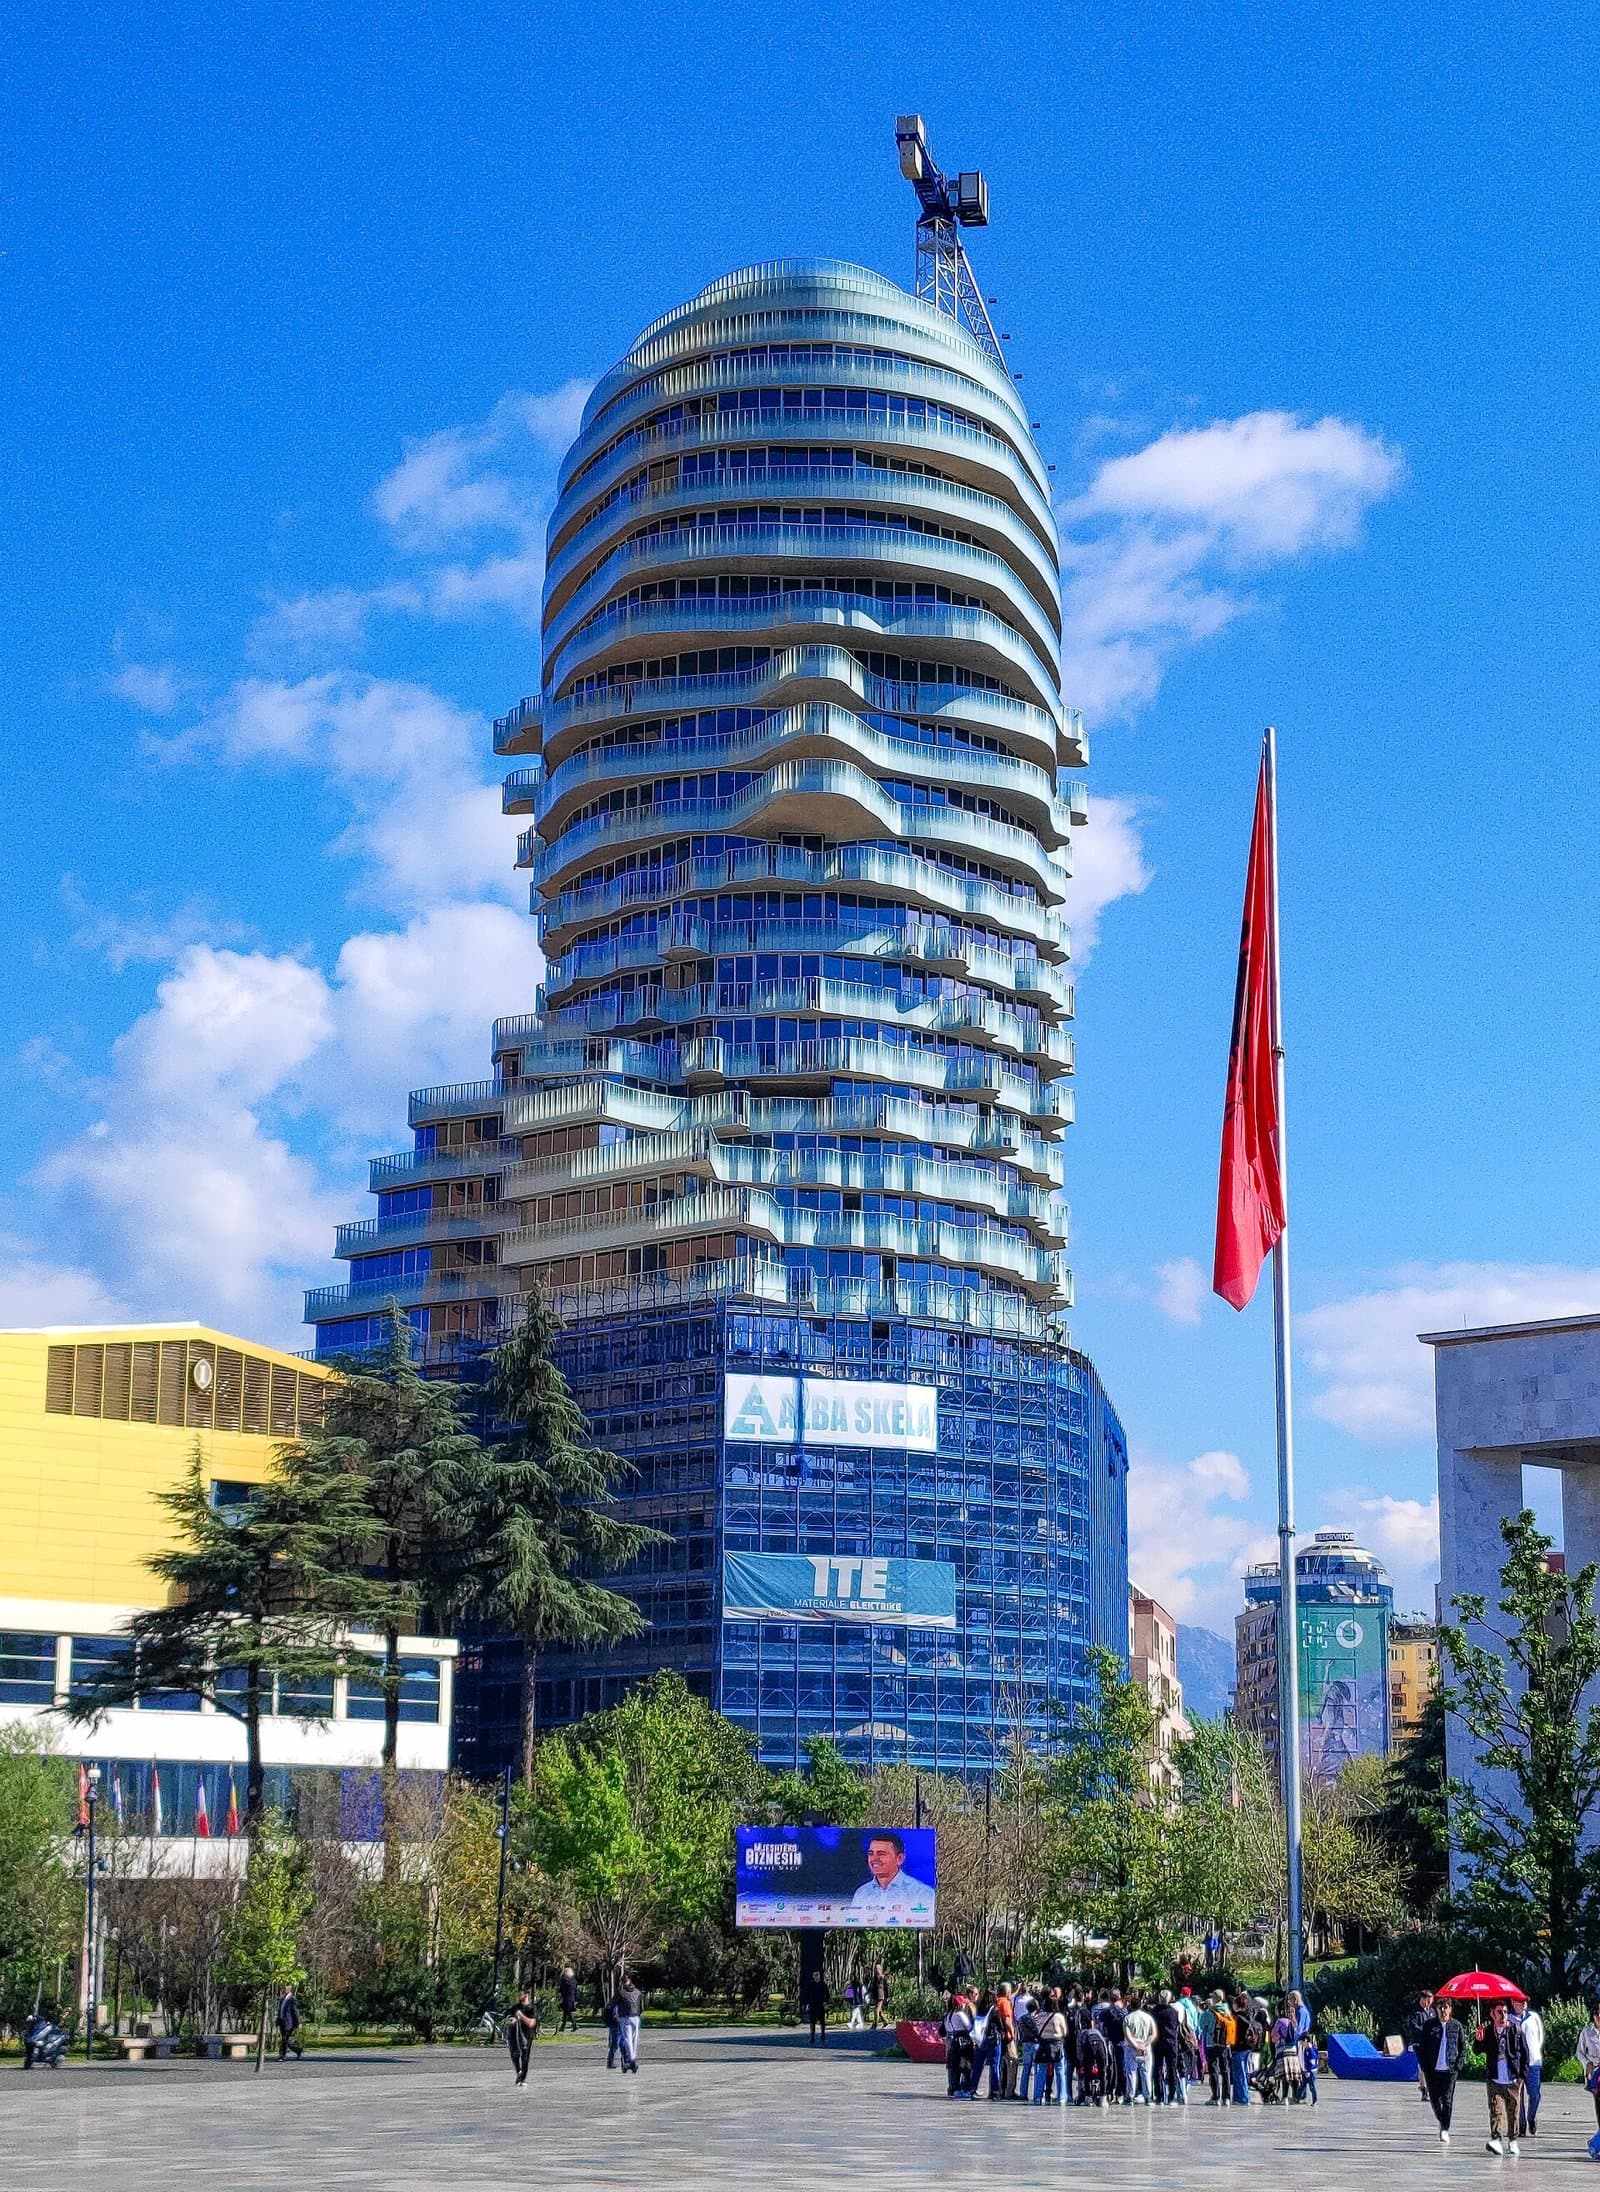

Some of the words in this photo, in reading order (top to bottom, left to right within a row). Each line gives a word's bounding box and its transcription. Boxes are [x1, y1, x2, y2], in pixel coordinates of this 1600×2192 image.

[854, 1396, 931, 1438] SKELA
[793, 1598, 846, 1610] MATERIALE
[849, 1600, 902, 1612] ELEKTRIKE
[745, 1848, 802, 1866] BIZNESIN
